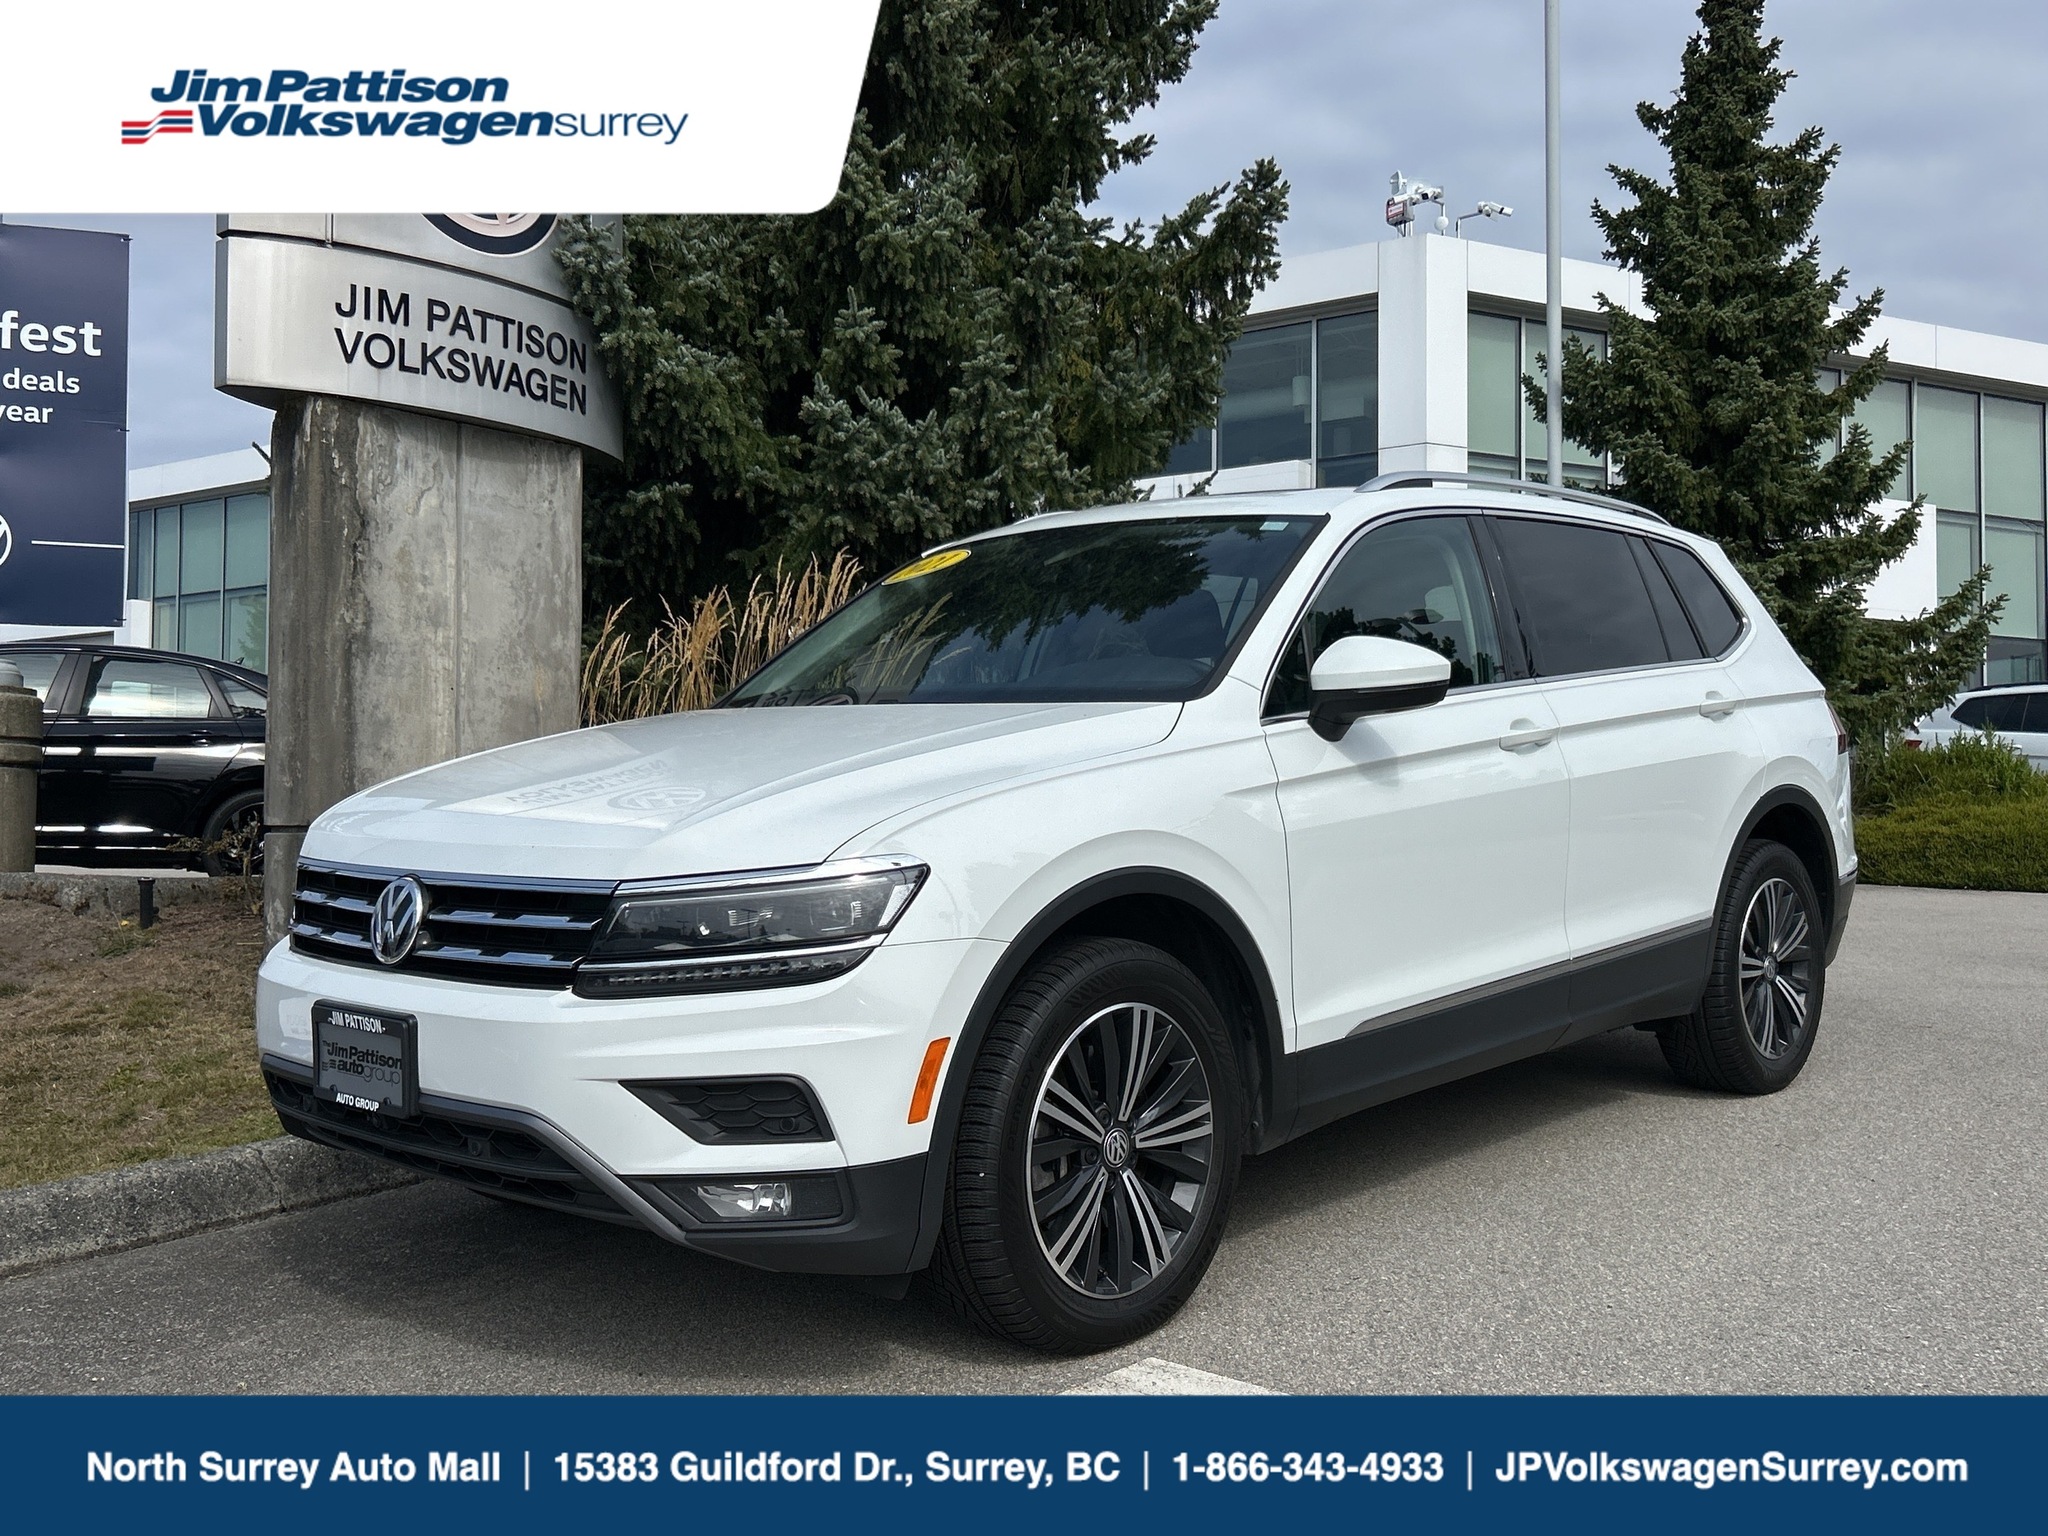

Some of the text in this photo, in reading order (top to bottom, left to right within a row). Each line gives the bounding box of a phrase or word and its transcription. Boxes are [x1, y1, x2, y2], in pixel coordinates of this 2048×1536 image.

[0, 310, 102, 357] fest
[335, 283, 587, 374] JIM PATTISON
[2, 367, 81, 394] deals
[334, 327, 587, 415] VOLKSWAGEN
[331, 1011, 344, 1027] JIM
[344, 1013, 382, 1034] PATTISON
[336, 1092, 380, 1112] AUTO GROUP
